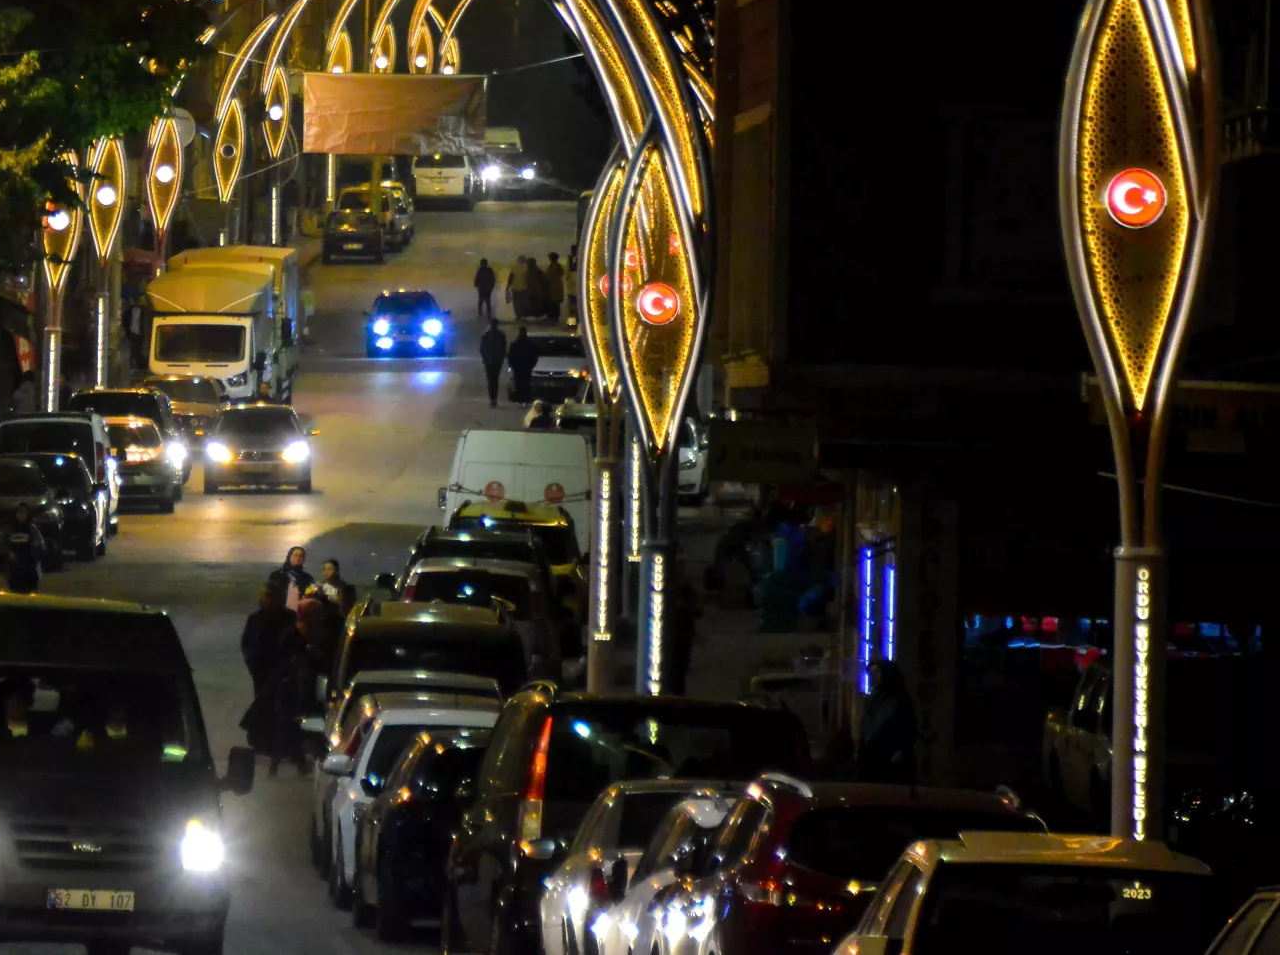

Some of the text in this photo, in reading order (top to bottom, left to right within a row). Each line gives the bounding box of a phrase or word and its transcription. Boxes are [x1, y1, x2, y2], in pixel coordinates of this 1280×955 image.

[652, 553, 664, 591] ORDU
[1136, 568, 1150, 620] ORDU
[82, 894, 97, 907] DY
[110, 894, 131, 909] 107
[1123, 888, 1152, 899] 2023
